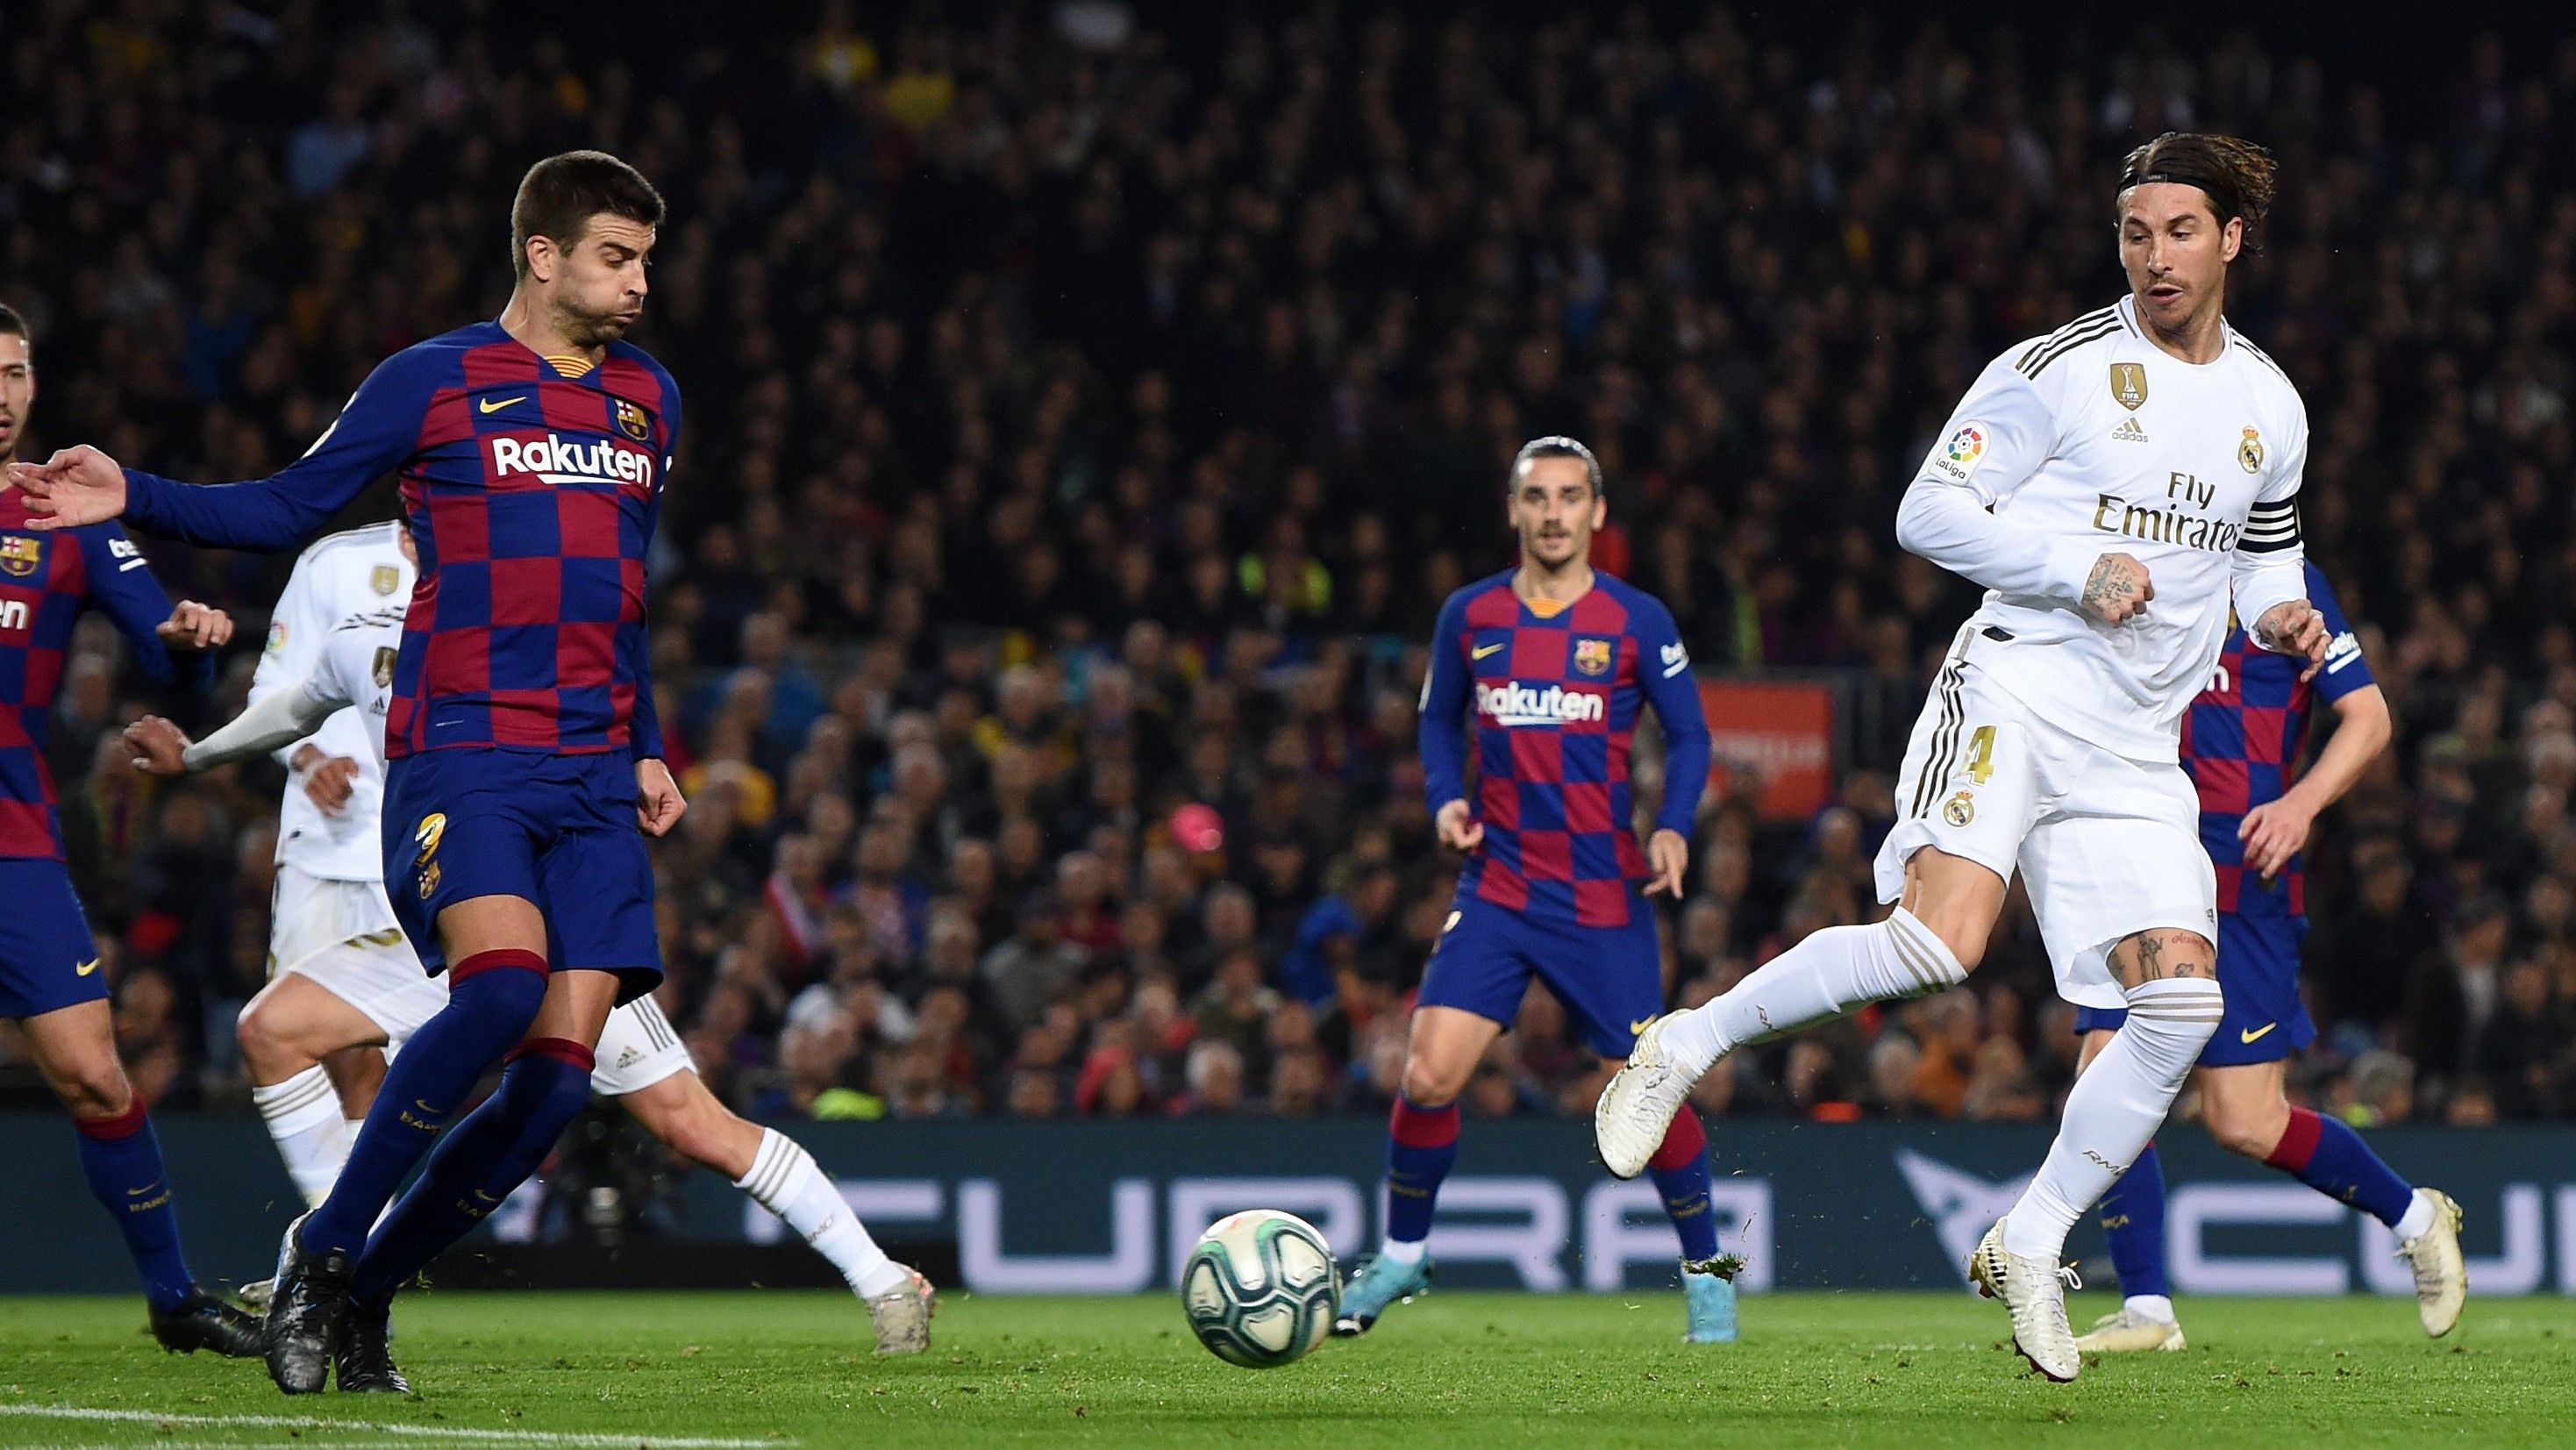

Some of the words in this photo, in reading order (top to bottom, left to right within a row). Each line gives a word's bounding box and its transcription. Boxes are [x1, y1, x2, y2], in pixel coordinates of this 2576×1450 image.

[2111, 430, 2149, 443] adidas
[492, 433, 652, 488] Rakuten
[1935, 457, 1966, 480] LaLiga
[2167, 471, 2216, 511] Fly
[1475, 681, 1604, 722] Rakuten
[1952, 725, 1996, 787] 4
[2167, 1182, 2576, 1296] CU
